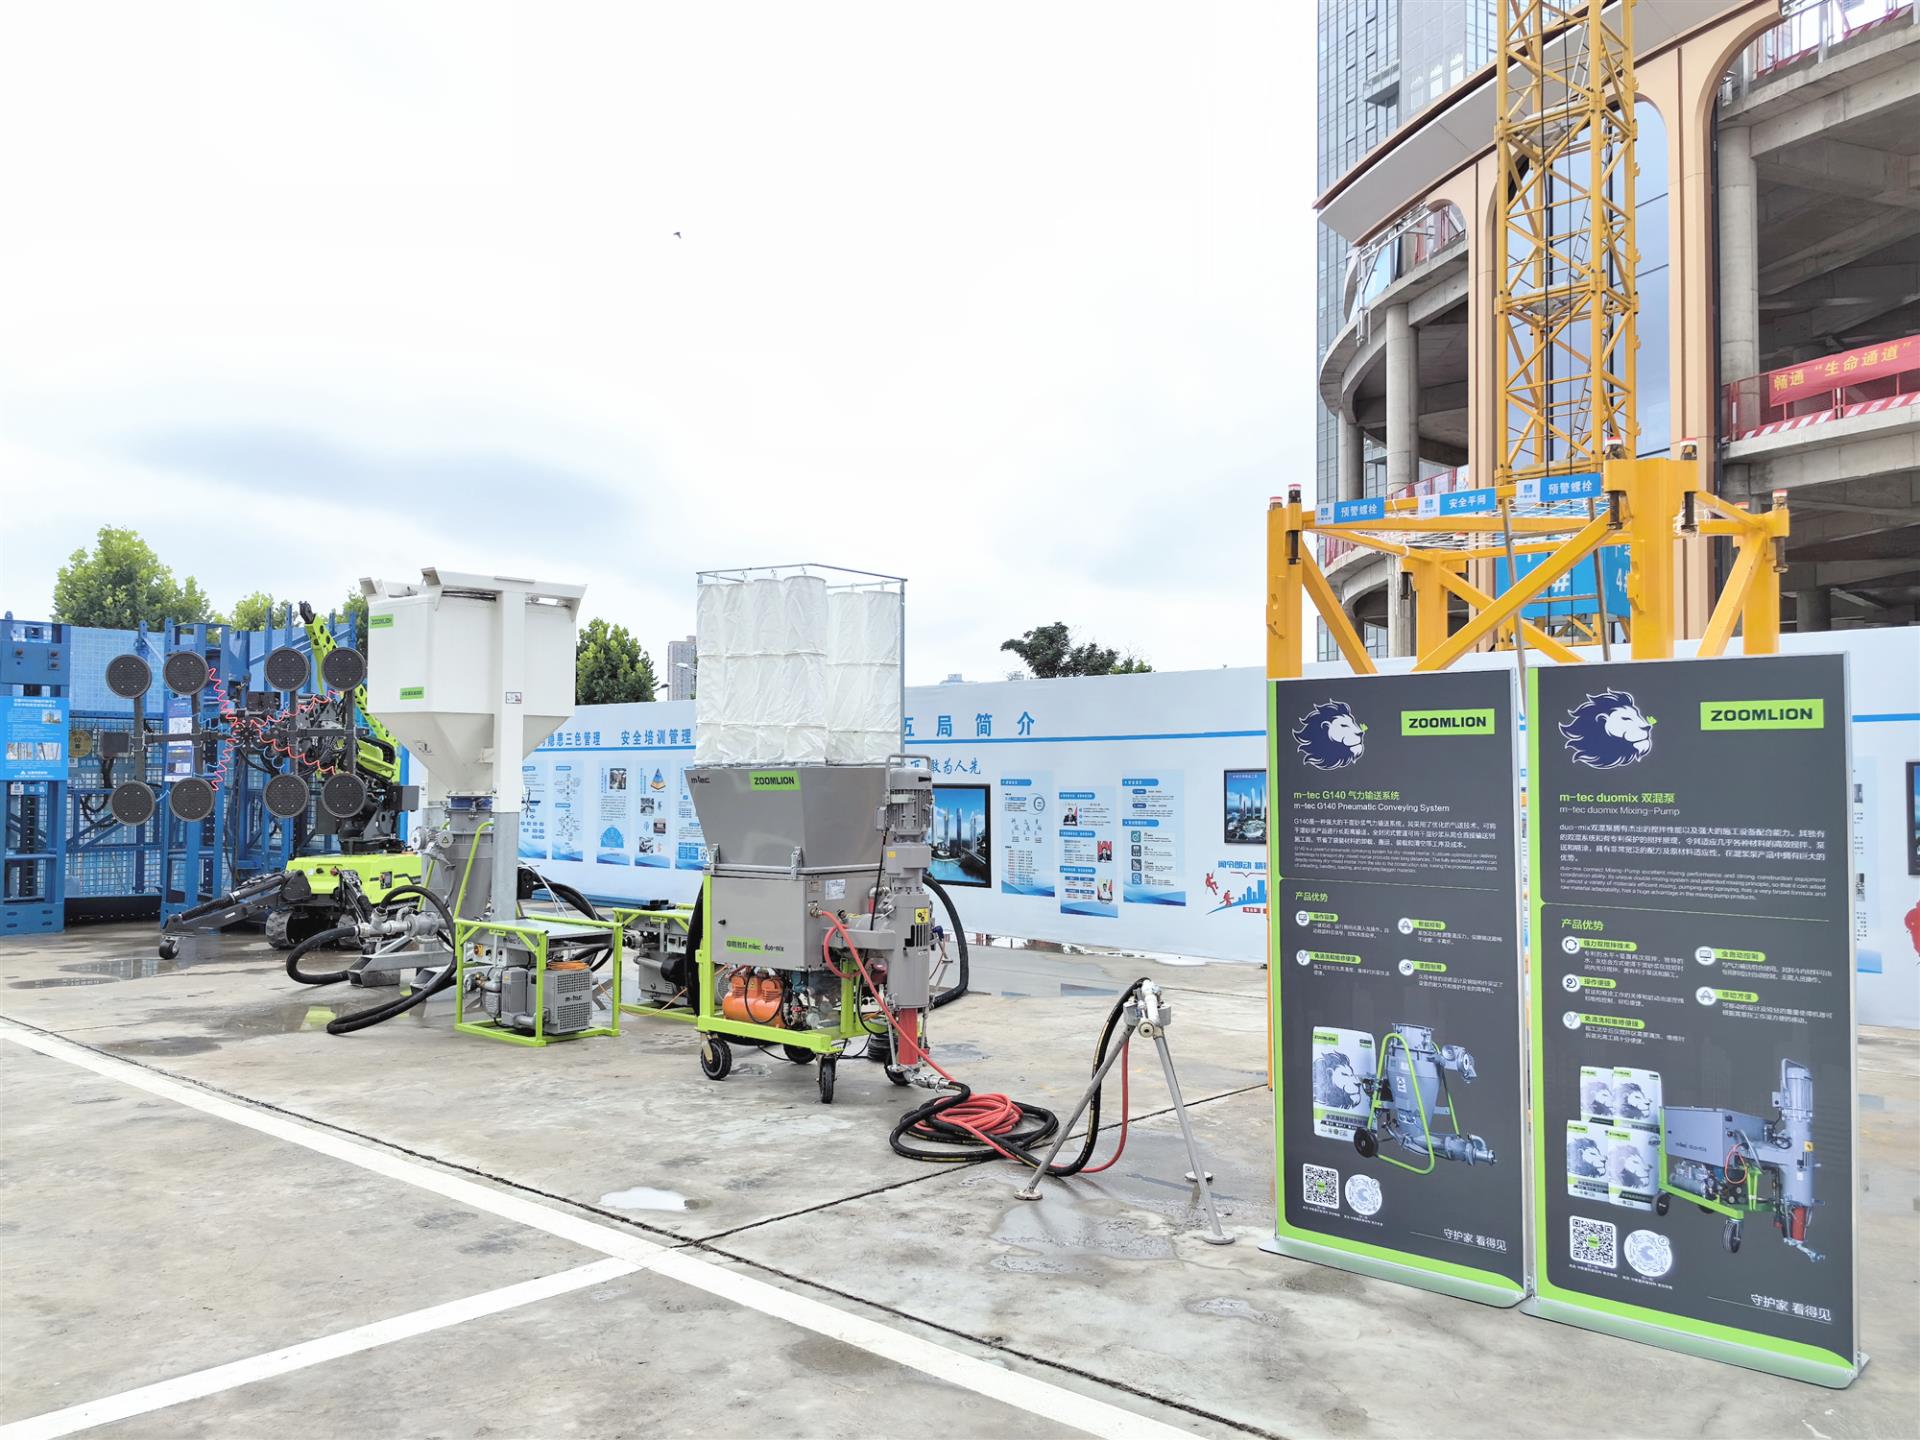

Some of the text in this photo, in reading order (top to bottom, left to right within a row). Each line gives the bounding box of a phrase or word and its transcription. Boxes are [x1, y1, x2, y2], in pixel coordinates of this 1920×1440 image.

[1549, 480, 1592, 495] 预警螺栓
[1449, 495, 1486, 509] 安全平网
[1340, 504, 1377, 518] 预警螺栓
[1711, 708, 1812, 721] ZOOMLION
[1409, 717, 1486, 728] ZOOMLION
[621, 728, 692, 745] 安全培训管理
[754, 776, 794, 785] ZOOMLION
[1294, 791, 1320, 799] m-tec
[1323, 790, 1346, 799] G140
[1560, 793, 1594, 802] m-tec
[1597, 792, 1638, 803] duomix
[1317, 802, 1336, 810] G140
[1338, 802, 1377, 810] Pneumatic
[1378, 803, 1419, 812] Conveying
[1420, 803, 1450, 813] System
[1587, 806, 1618, 814] duomix
[1620, 806, 1680, 816] Mixing-Pump
[1296, 891, 1328, 903] 产品优势
[1561, 918, 1604, 931] 产品优势
[1444, 1228, 1506, 1251] 守护家 看得见
[1751, 1294, 1831, 1321] 守护家 看得见
